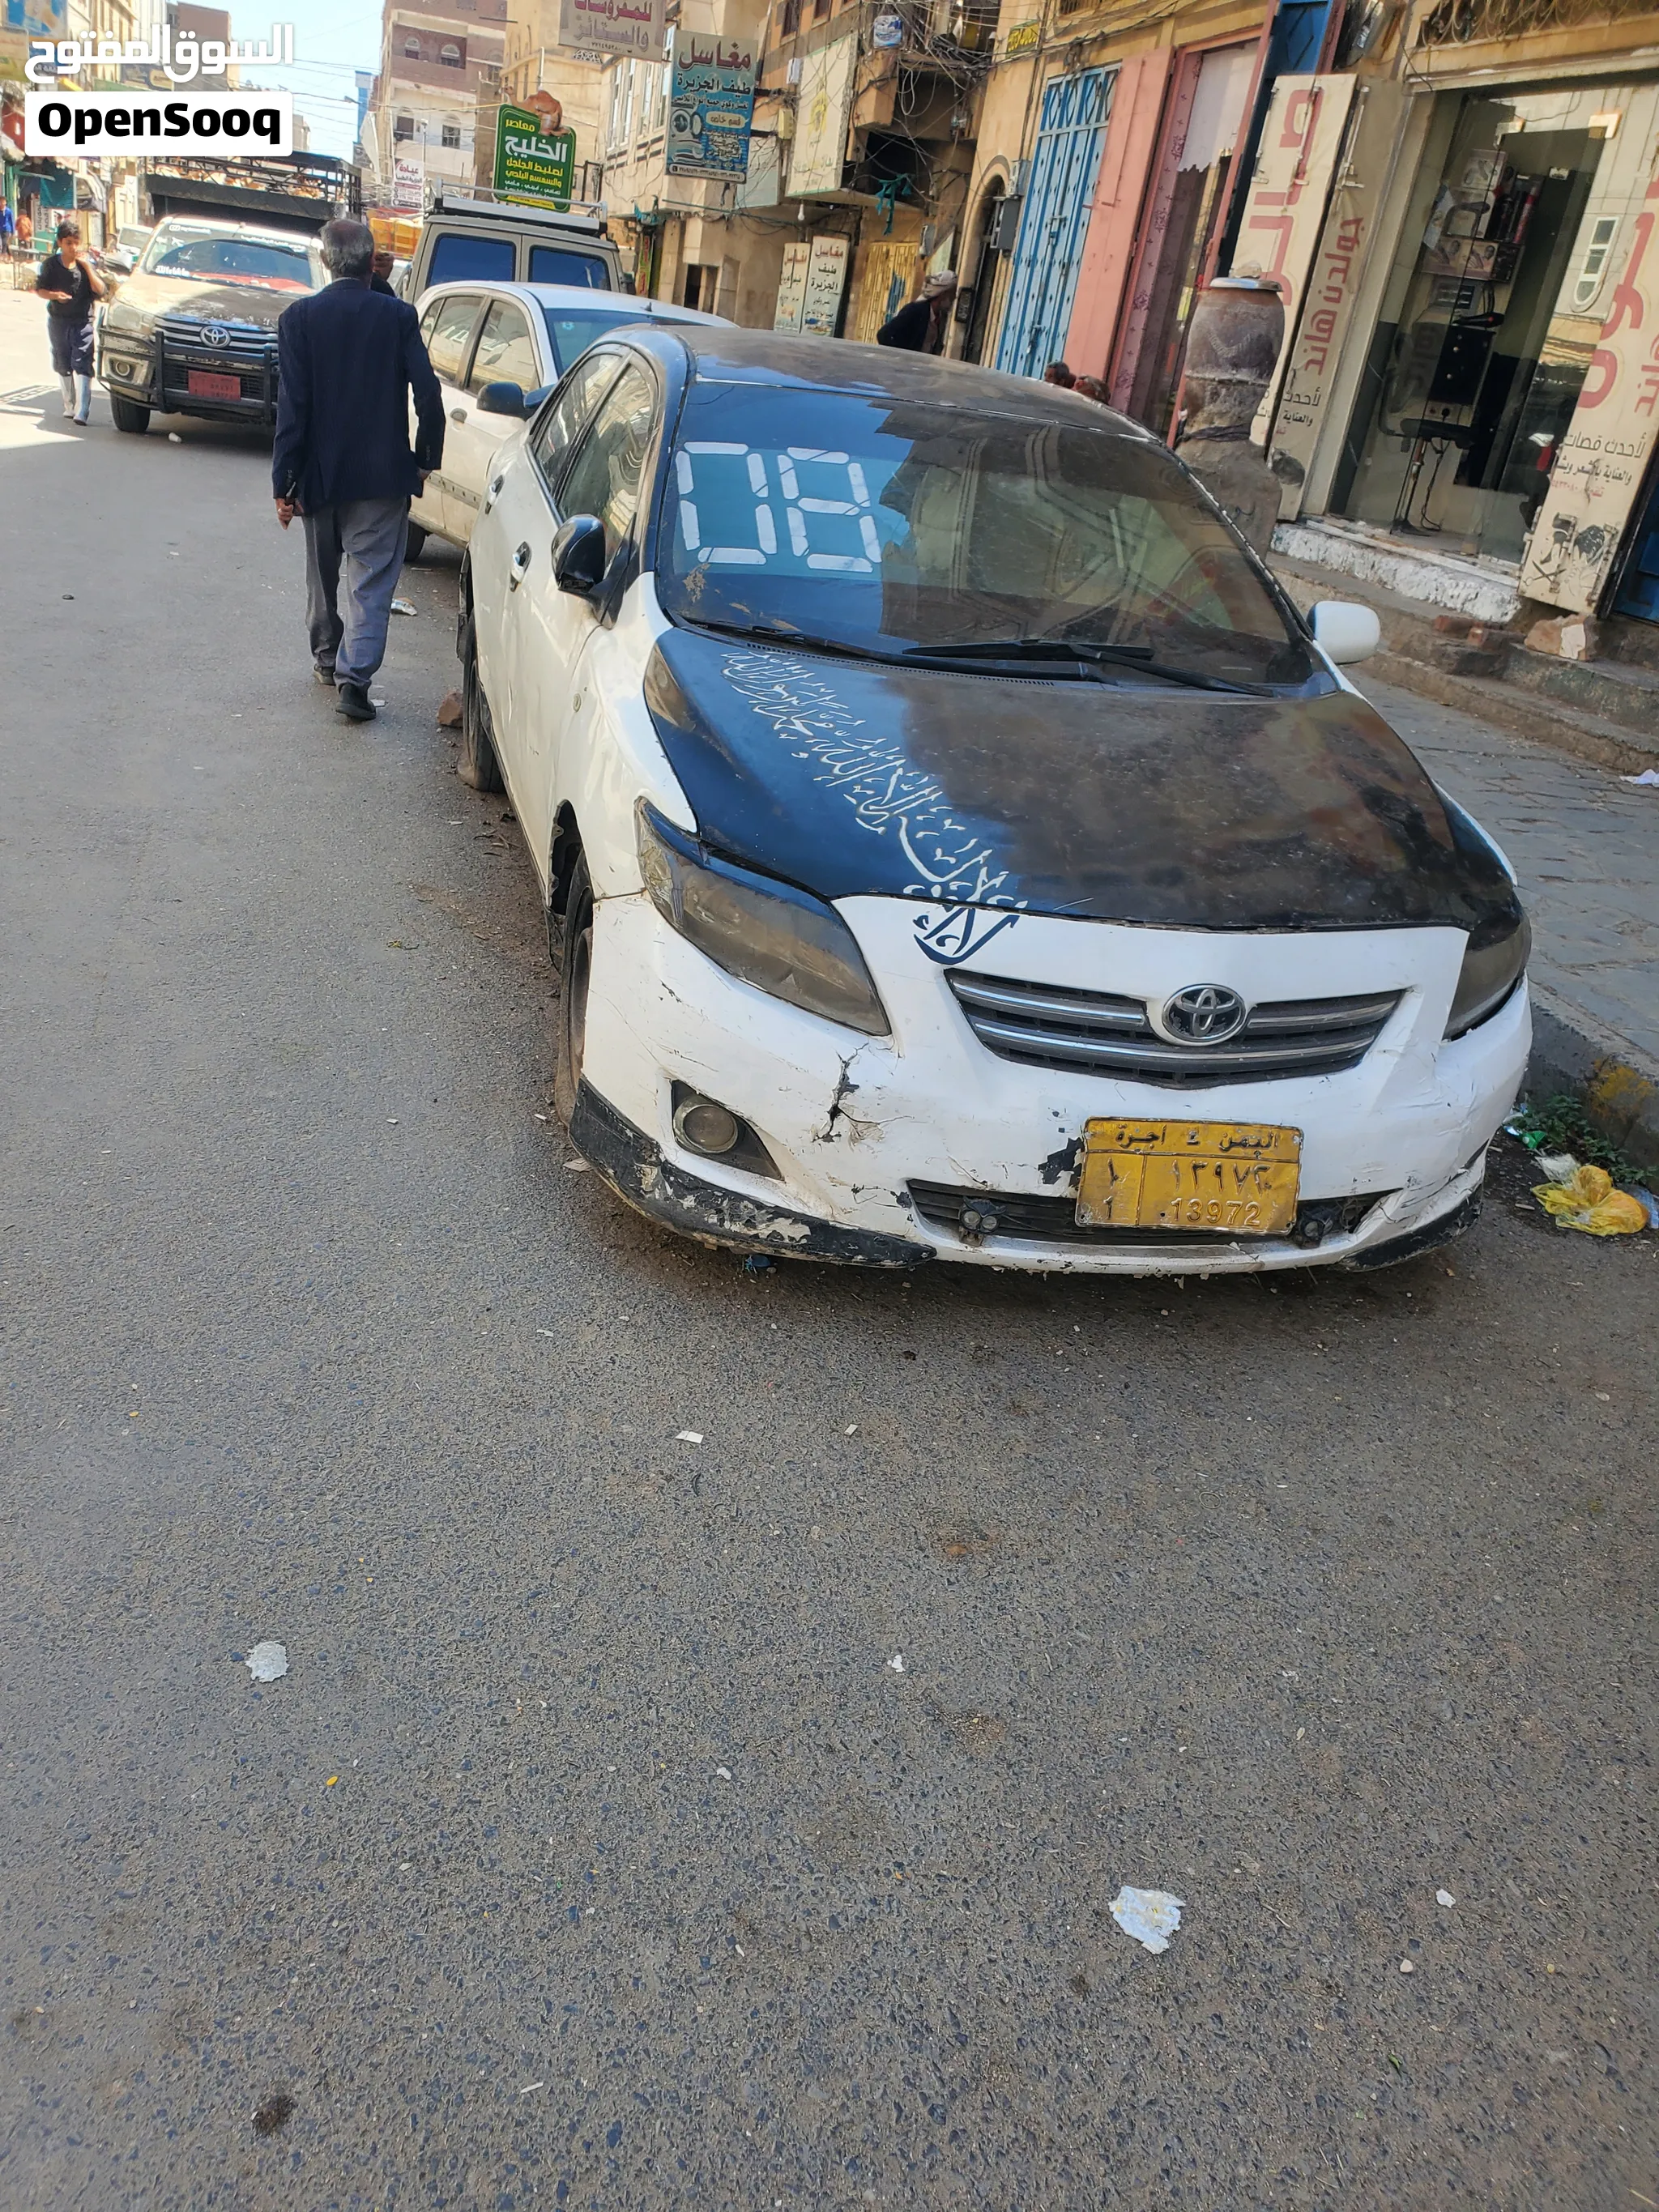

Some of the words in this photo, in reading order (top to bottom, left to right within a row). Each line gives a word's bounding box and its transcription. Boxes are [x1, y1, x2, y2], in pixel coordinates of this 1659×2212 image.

[678, 37, 752, 71] مغاسل
[677, 73, 719, 92] الجزيرة
[722, 79, 751, 98] طيف
[505, 119, 535, 132] معاصر
[505, 135, 569, 163] الخليج
[529, 174, 562, 188] والسمسم
[815, 244, 844, 259] مغاسل
[1324, 217, 1365, 304] جولدن
[818, 262, 837, 276] طيف
[810, 277, 838, 292] الجزيرة
[1303, 309, 1338, 376] هاند
[1283, 409, 1314, 427] والعناية
[1564, 431, 1602, 451] قصات
[1605, 432, 1647, 458] لأحدث
[1603, 464, 1633, 486] والعناية
[1218, 1129, 1279, 1157] اليمن
[1172, 1158, 1272, 1197] ١٣٩٧٢
[1170, 1196, 1262, 1227] 13972
